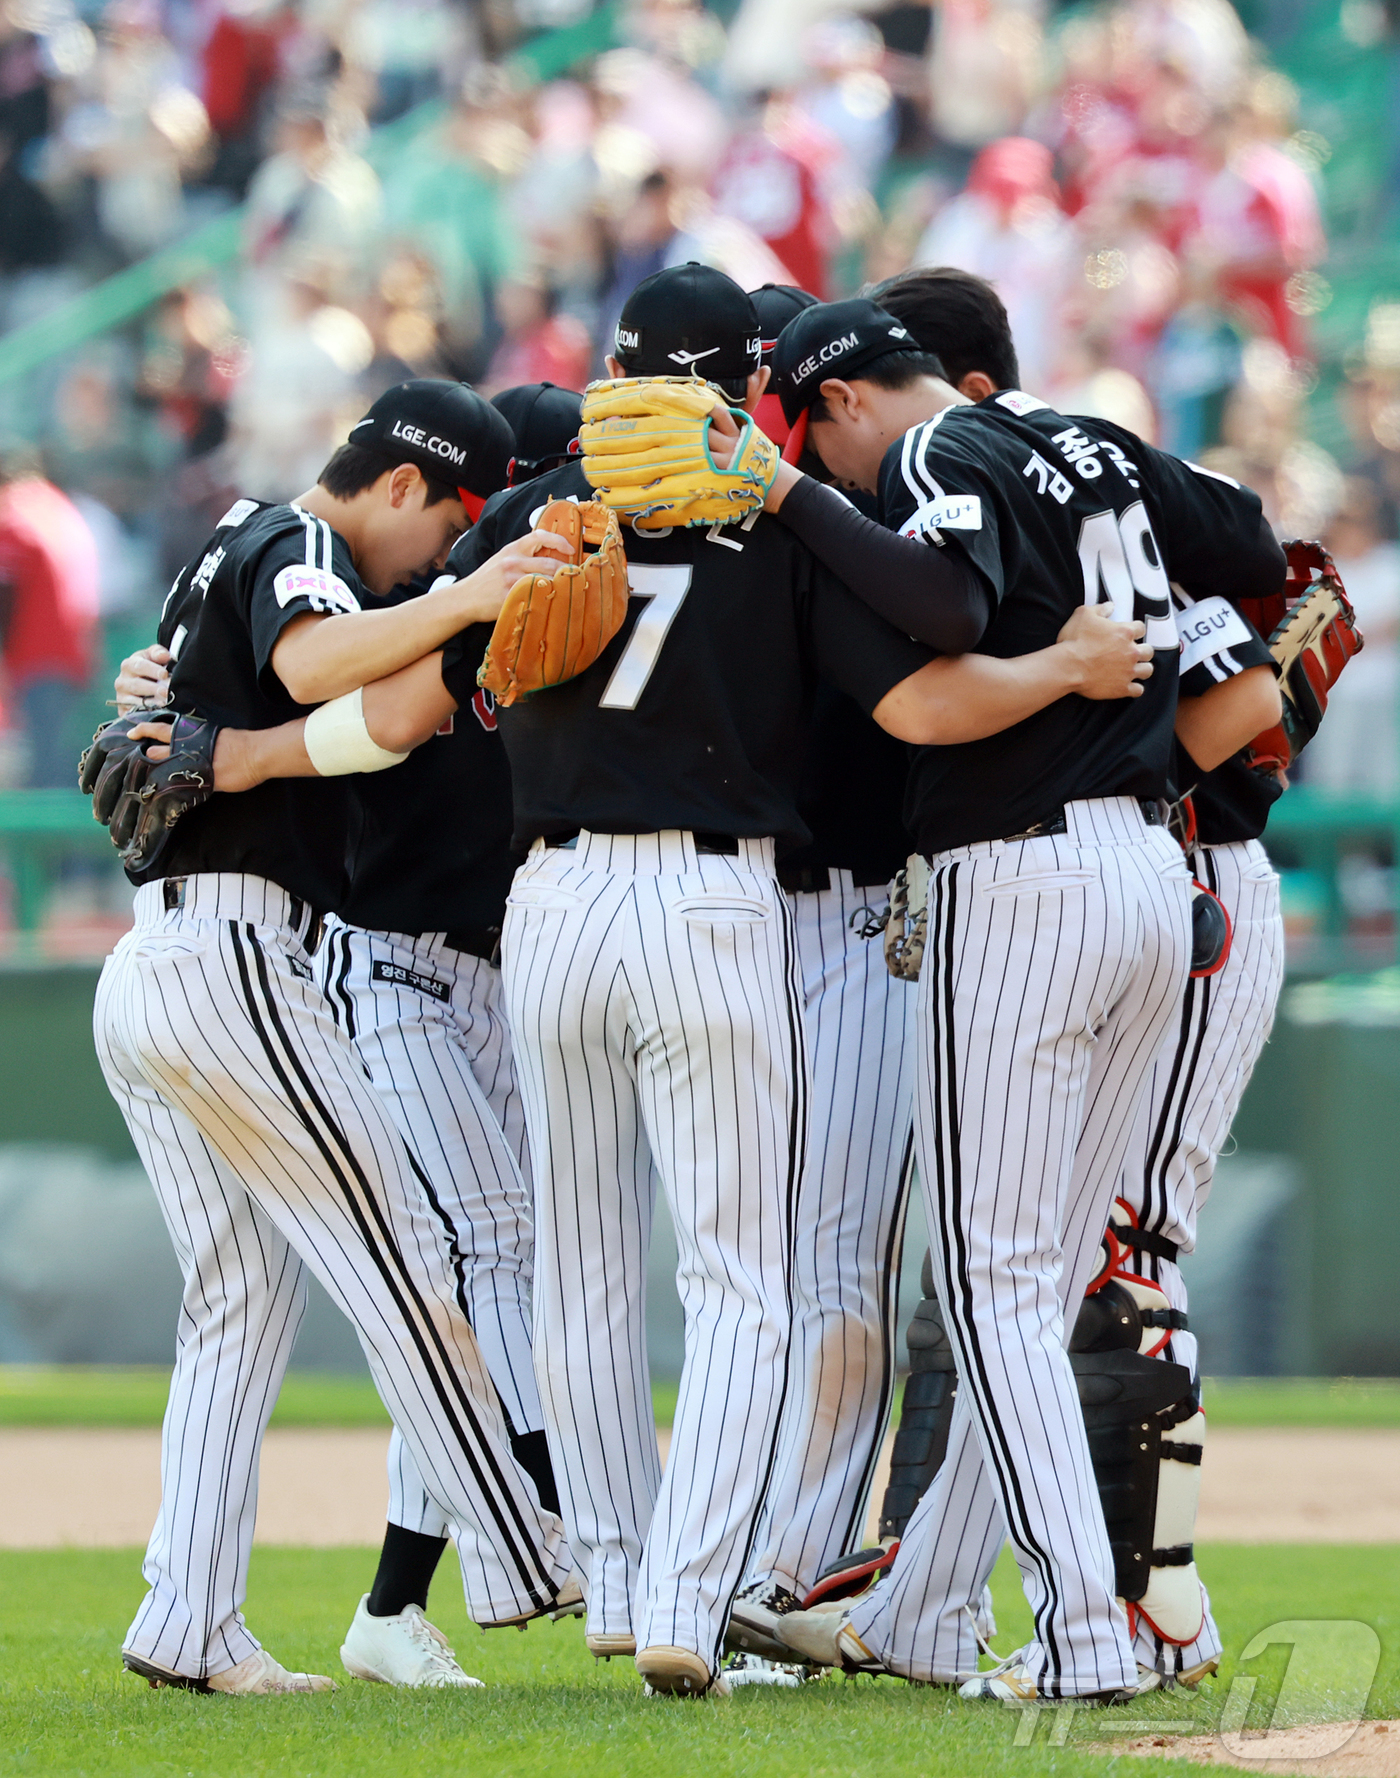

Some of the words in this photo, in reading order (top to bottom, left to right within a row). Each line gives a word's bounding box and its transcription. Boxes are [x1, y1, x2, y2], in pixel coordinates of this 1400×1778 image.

[791, 331, 860, 386] LGE.COM
[391, 419, 468, 466] LGE.COM
[1076, 500, 1180, 651] 49
[599, 562, 693, 711] 7
[380, 964, 407, 981] 영진
